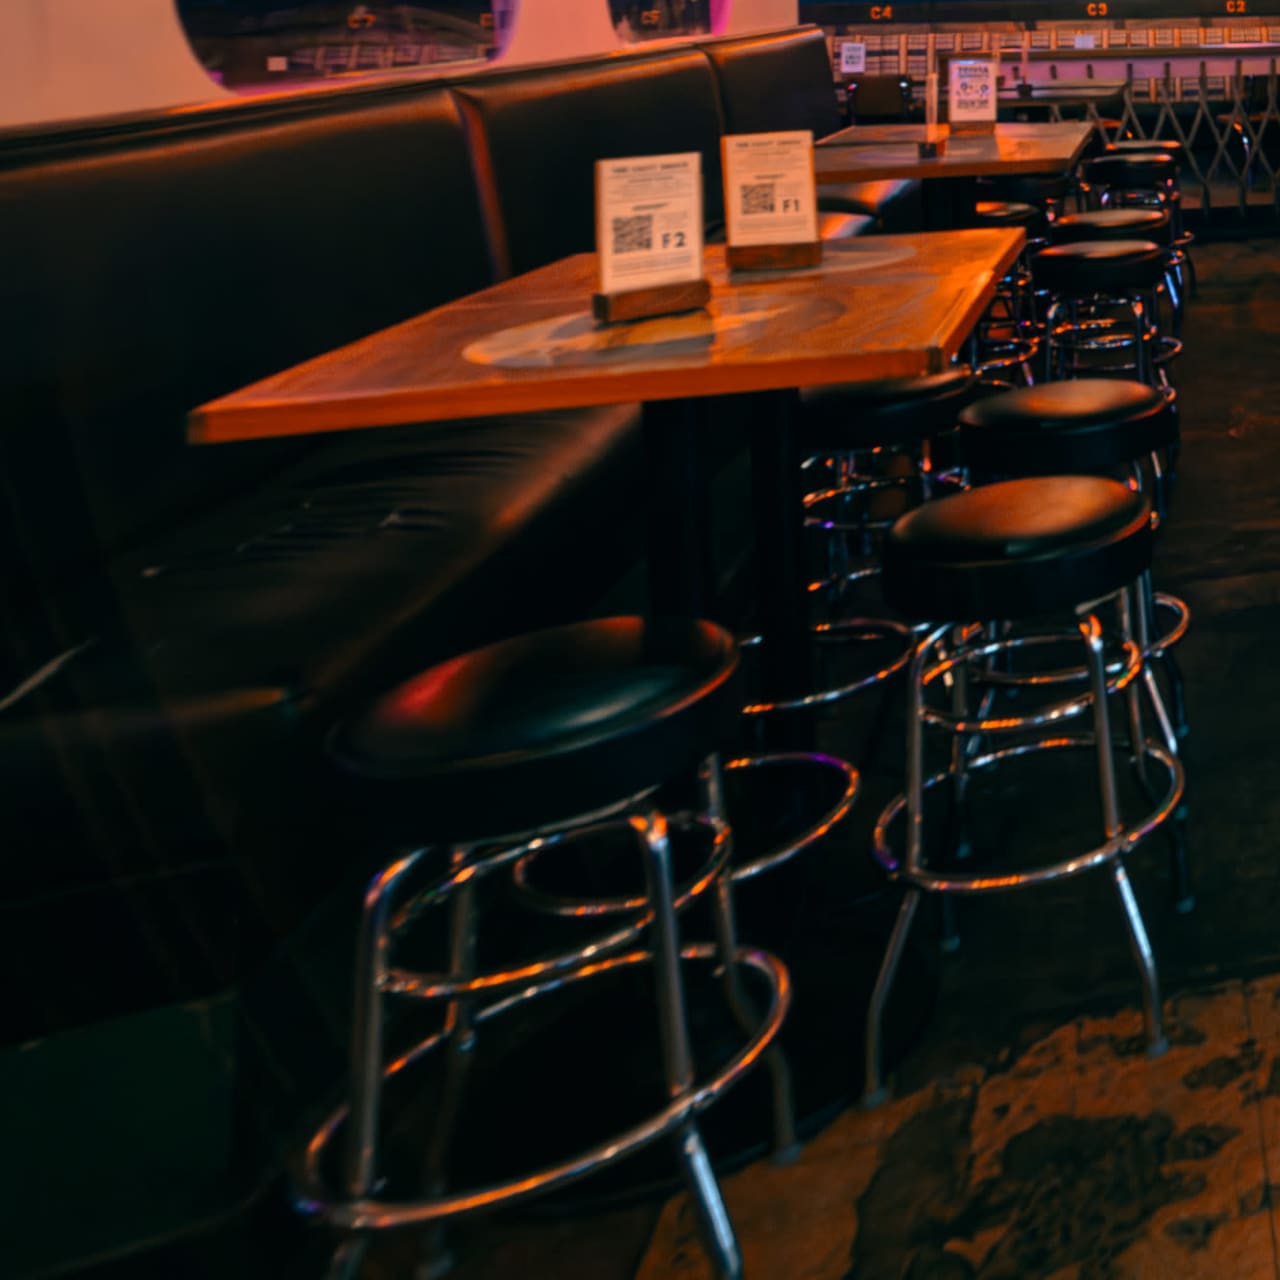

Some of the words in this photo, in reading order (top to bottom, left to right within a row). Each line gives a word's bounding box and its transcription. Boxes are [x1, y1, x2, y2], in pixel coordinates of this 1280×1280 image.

[870, 5, 893, 20] C4
[1086, 2, 1108, 17] C3
[1225, 0, 1246, 13] C2
